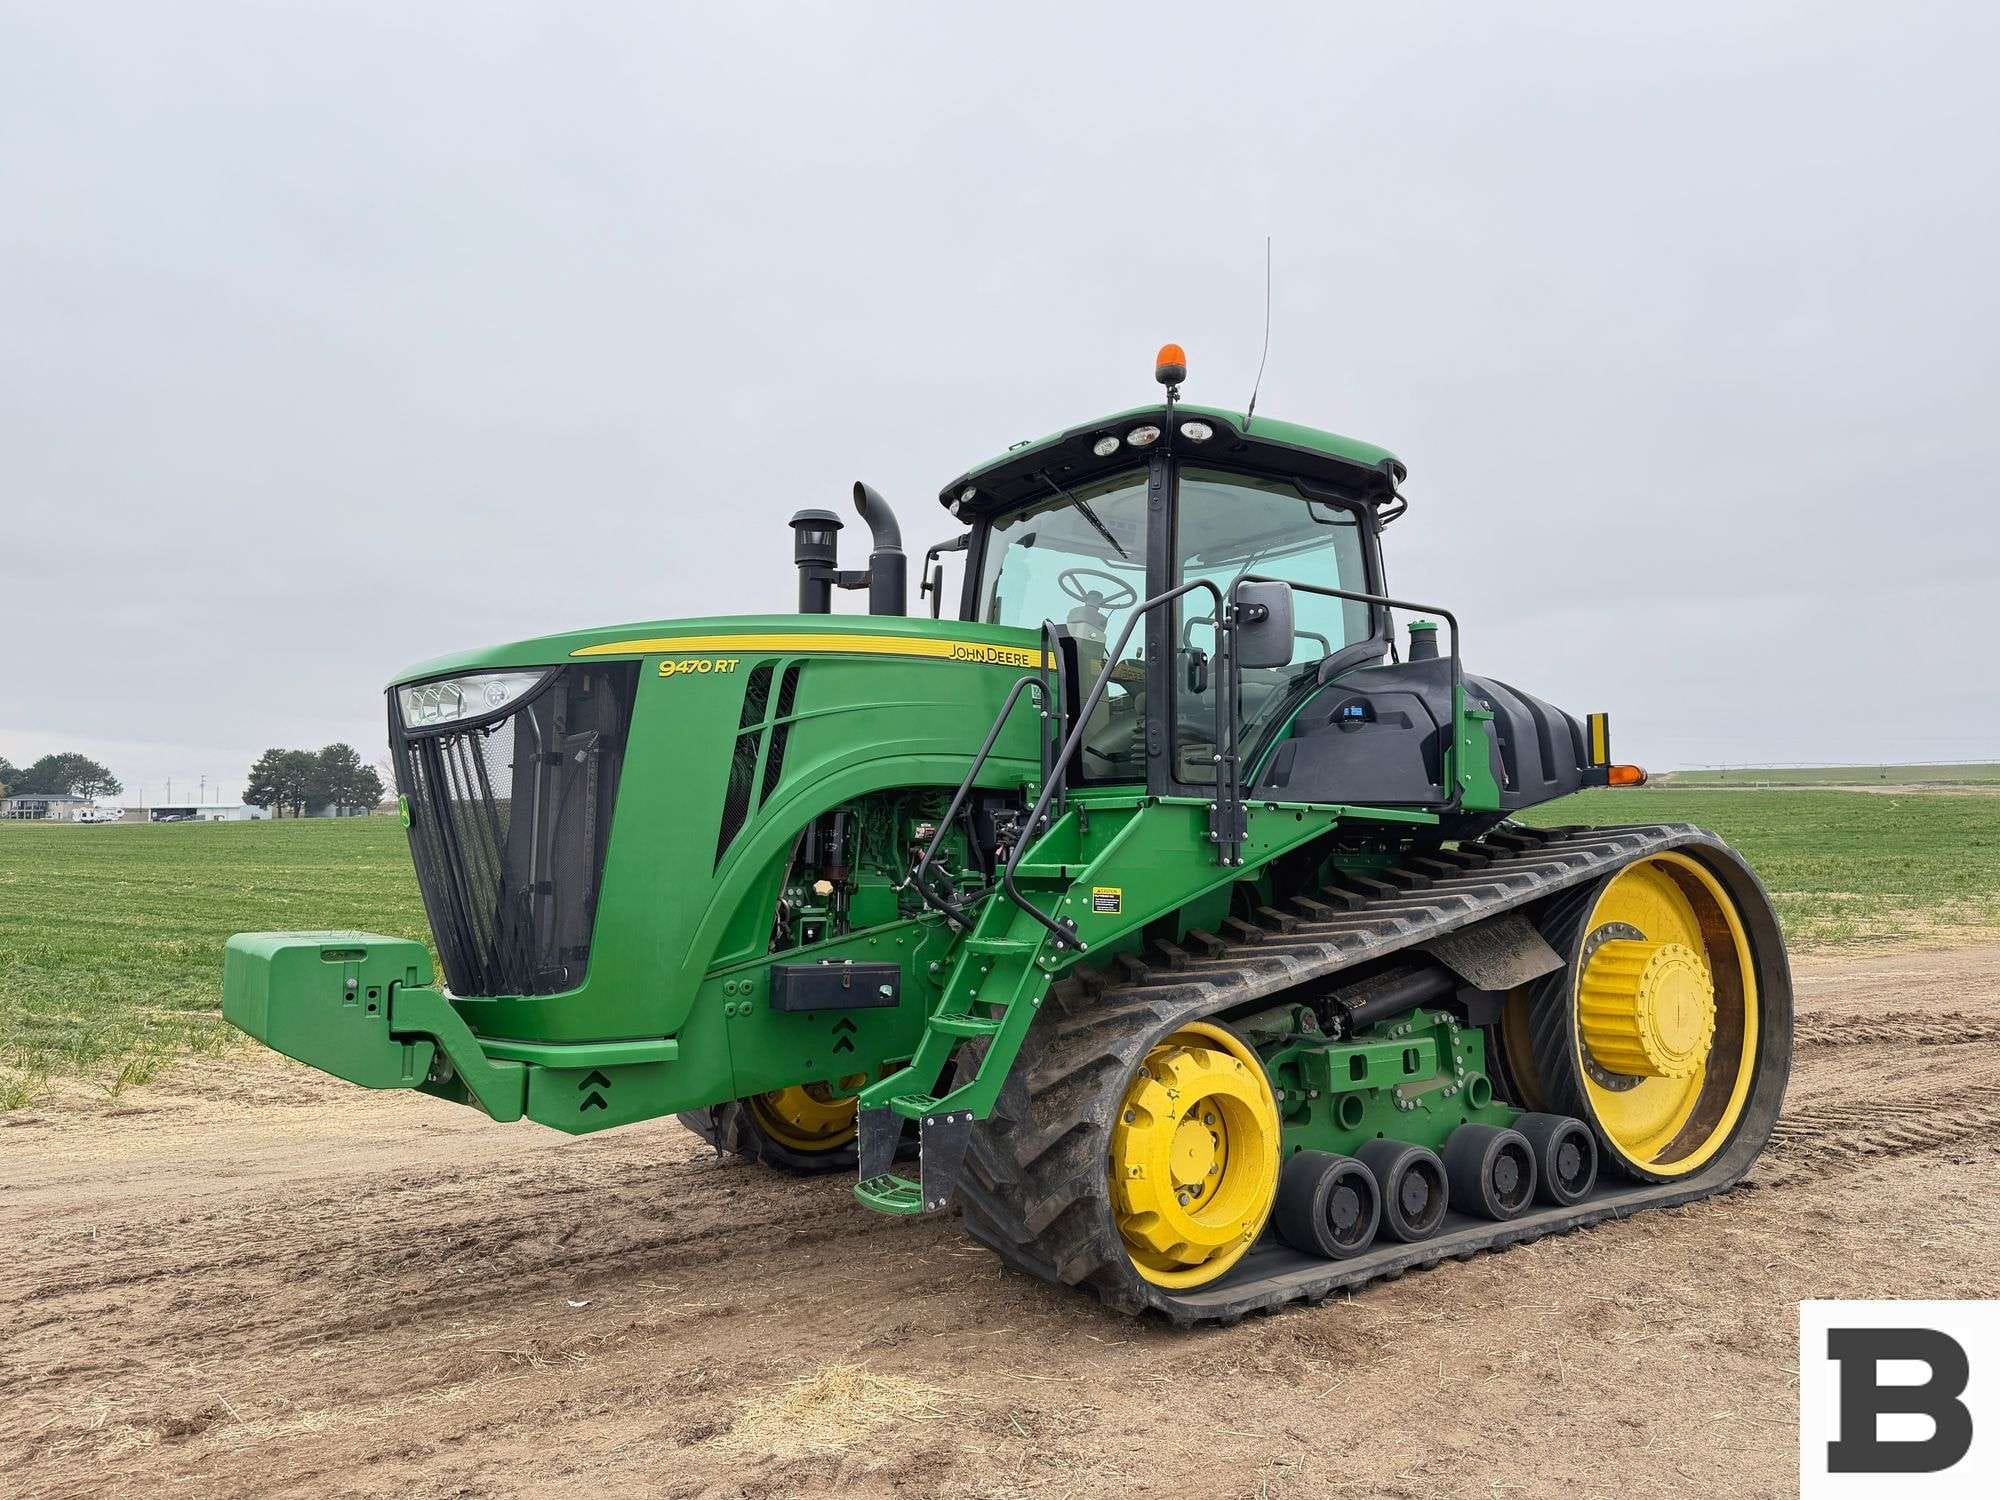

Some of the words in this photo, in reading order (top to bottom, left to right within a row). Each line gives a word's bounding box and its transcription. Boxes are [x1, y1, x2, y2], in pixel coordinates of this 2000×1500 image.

[949, 644, 985, 661] JOHN
[987, 647, 1030, 666] DEERE
[658, 660, 713, 677] 9470
[714, 659, 740, 673] RT
